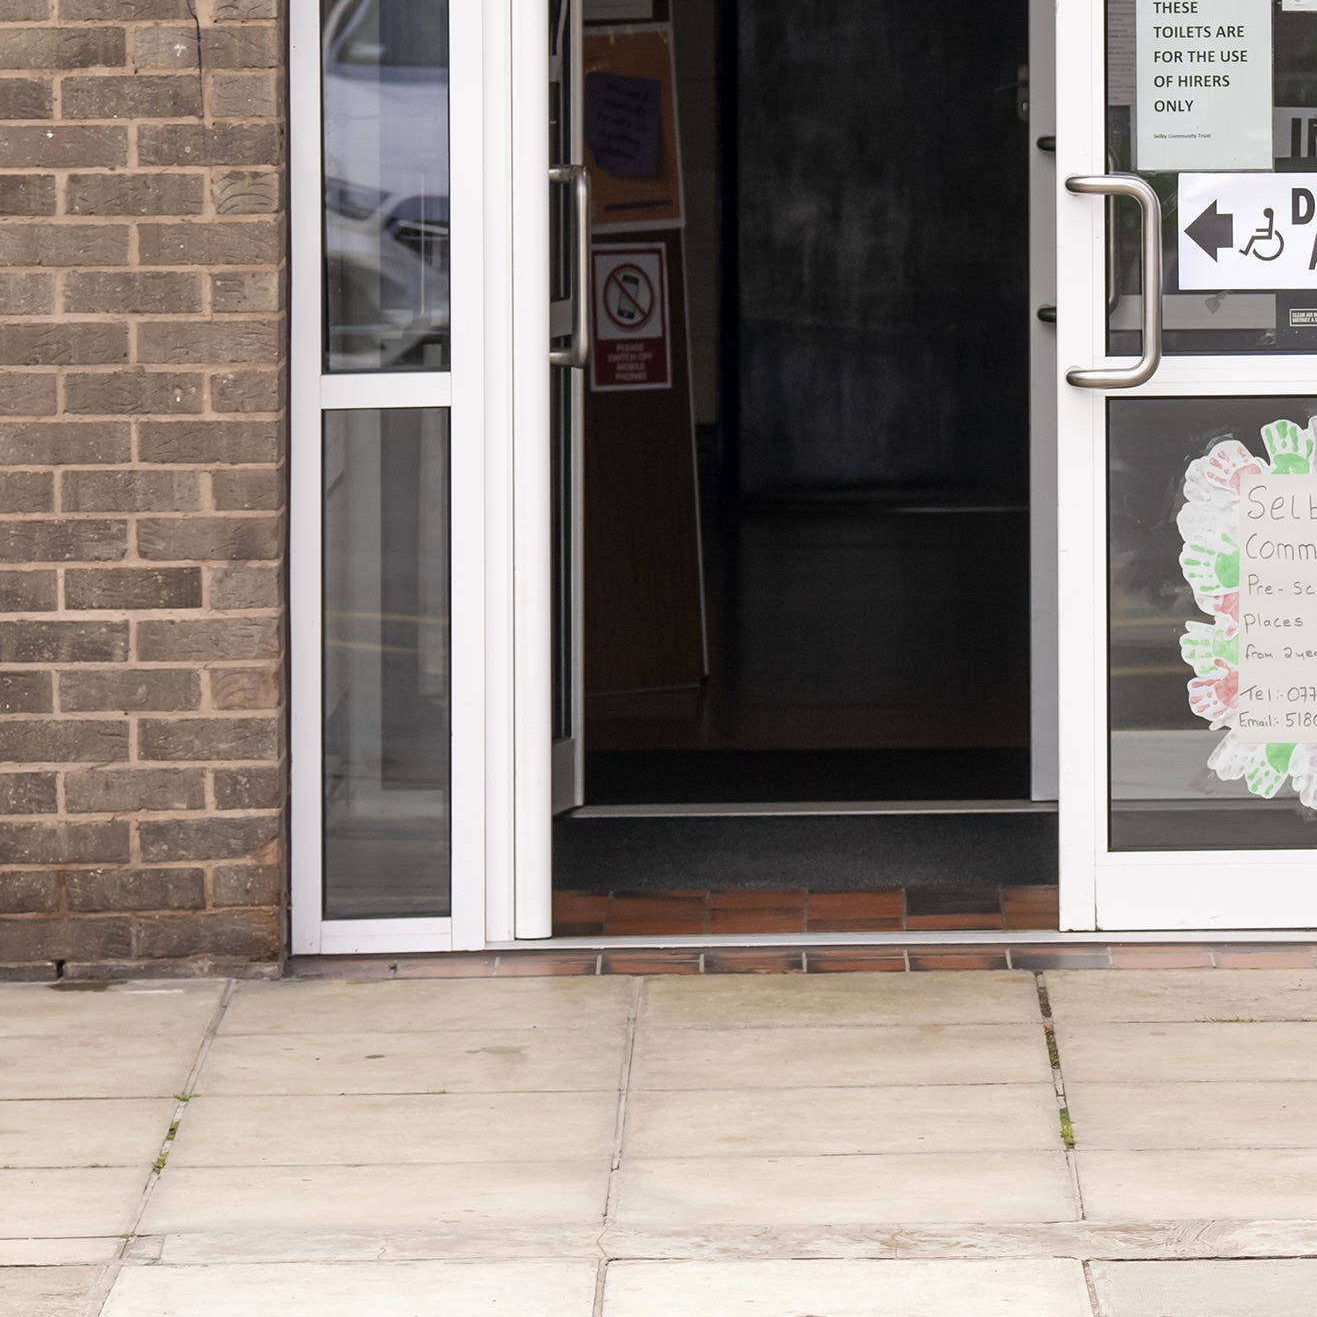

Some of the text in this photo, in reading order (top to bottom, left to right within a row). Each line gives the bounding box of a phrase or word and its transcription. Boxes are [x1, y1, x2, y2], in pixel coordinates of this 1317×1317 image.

[1153, 1, 1198, 13] THESE
[1153, 25, 1245, 38] TOILETS ARE
[1154, 50, 1248, 63] FOR THE USE
[1154, 75, 1230, 88] OF HIRERS
[1154, 100, 1194, 112] ONLY
[1245, 644, 1273, 660] from
